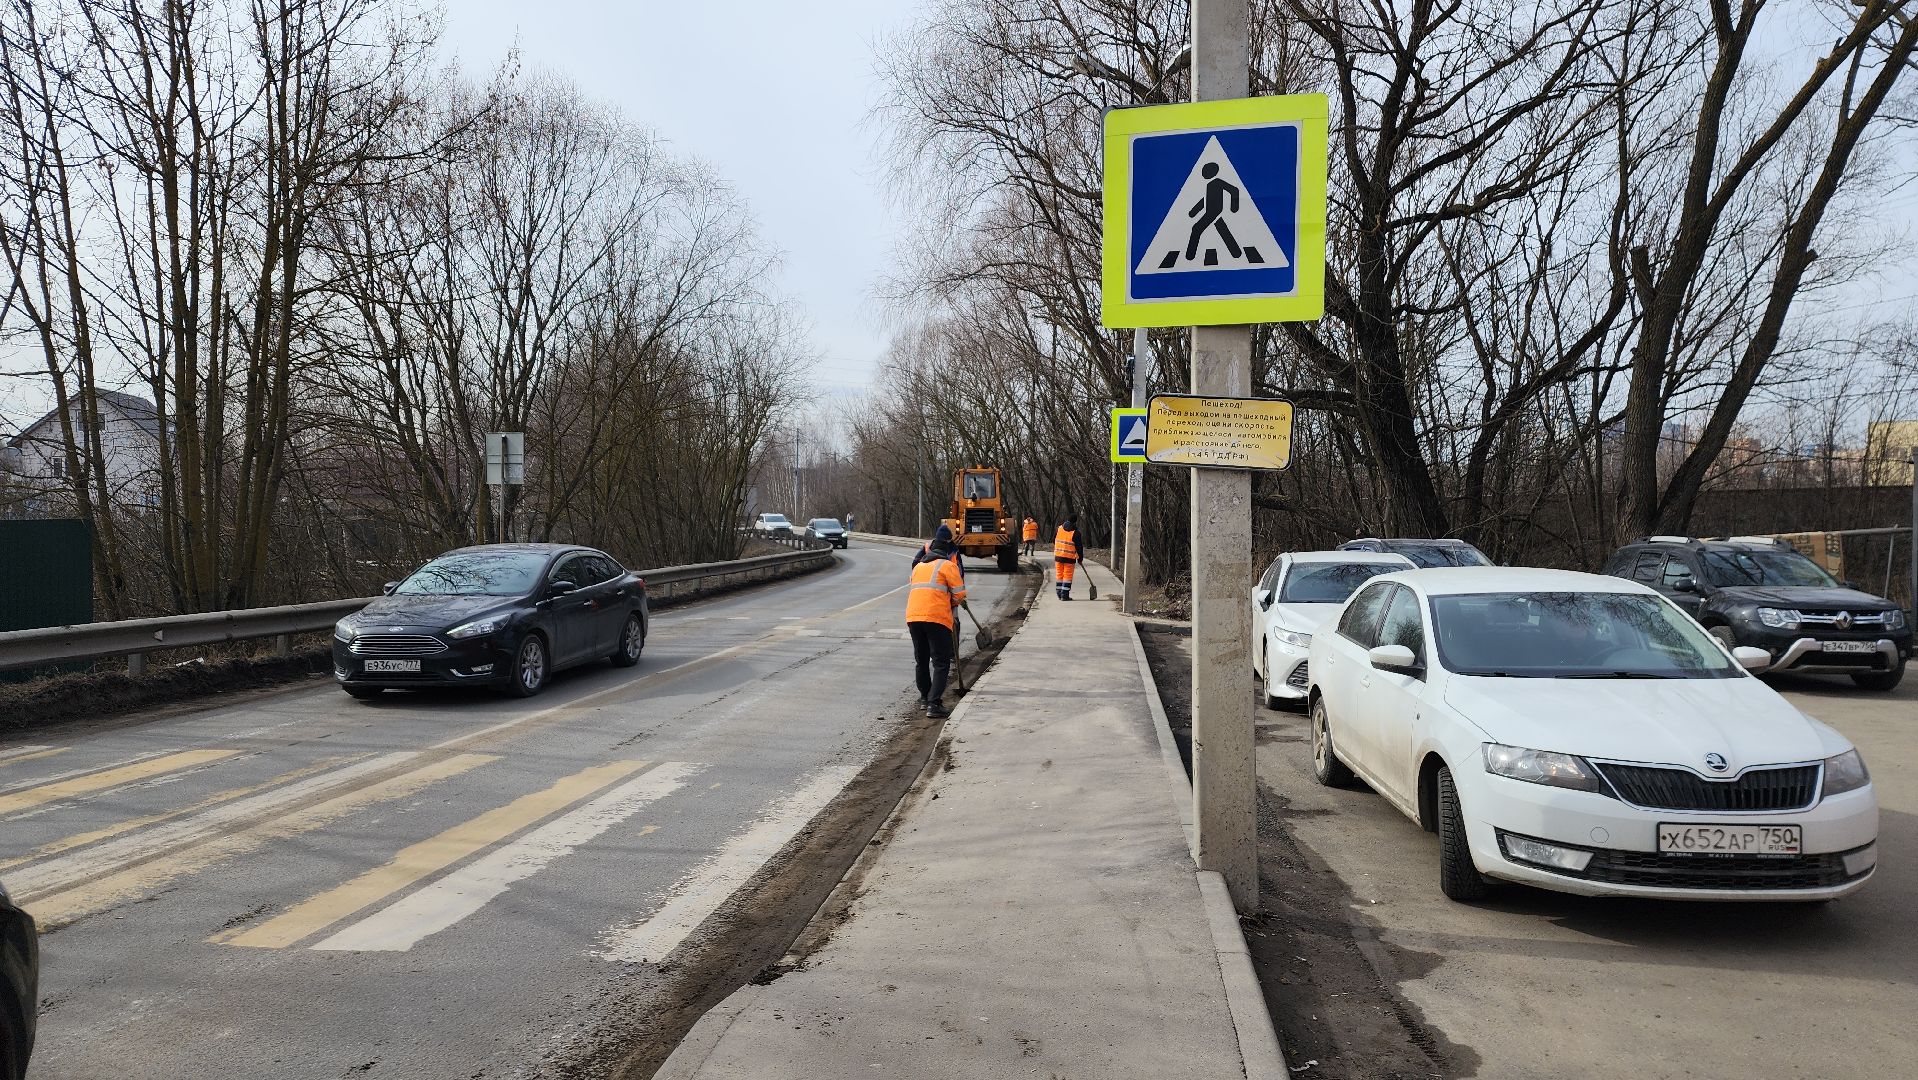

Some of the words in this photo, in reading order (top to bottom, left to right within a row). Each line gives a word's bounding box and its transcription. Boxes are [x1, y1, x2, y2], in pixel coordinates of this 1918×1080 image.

[1202, 400, 1242, 408] Пешеход!
[1153, 428, 1231, 437] приближающегося
[1668, 828, 1754, 850] Х652АР
[1760, 828, 1794, 844] 750
